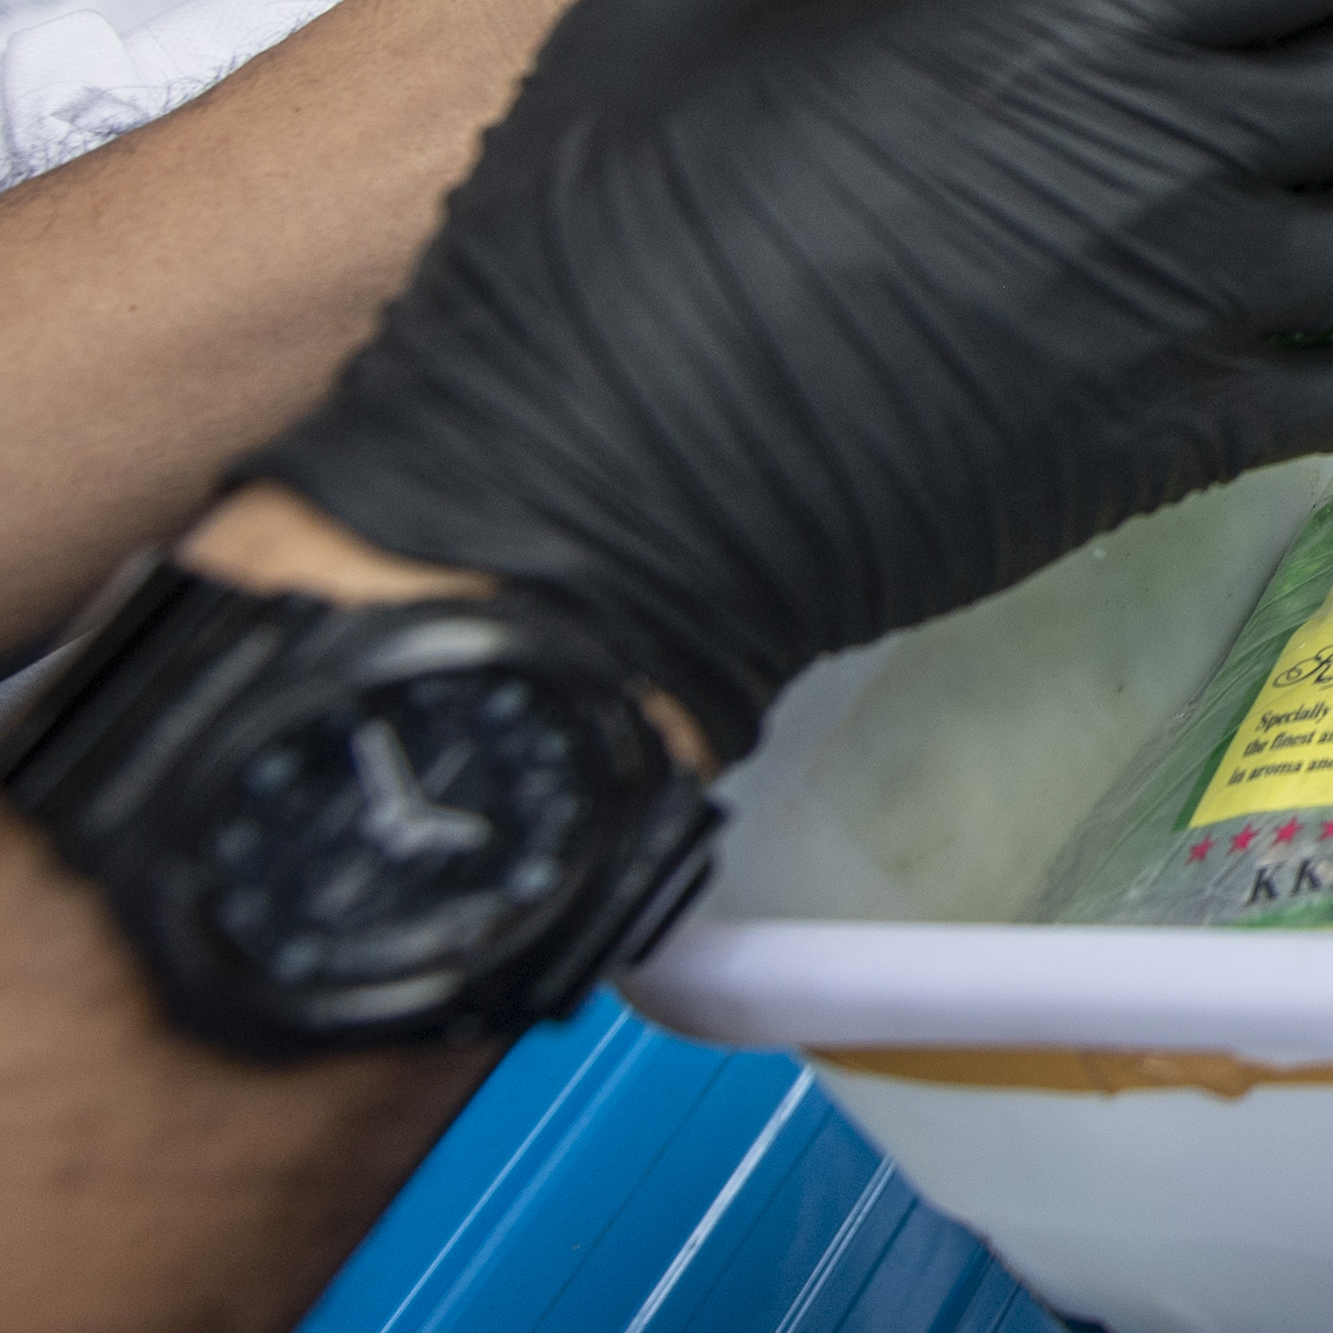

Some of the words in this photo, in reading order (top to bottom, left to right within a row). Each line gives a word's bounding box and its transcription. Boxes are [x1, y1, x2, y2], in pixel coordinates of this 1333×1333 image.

[1258, 698, 1331, 730] Specially
[1243, 734, 1271, 759] the
[1270, 723, 1317, 750] finest
[1227, 767, 1245, 787] in
[1246, 758, 1302, 784] aroma
